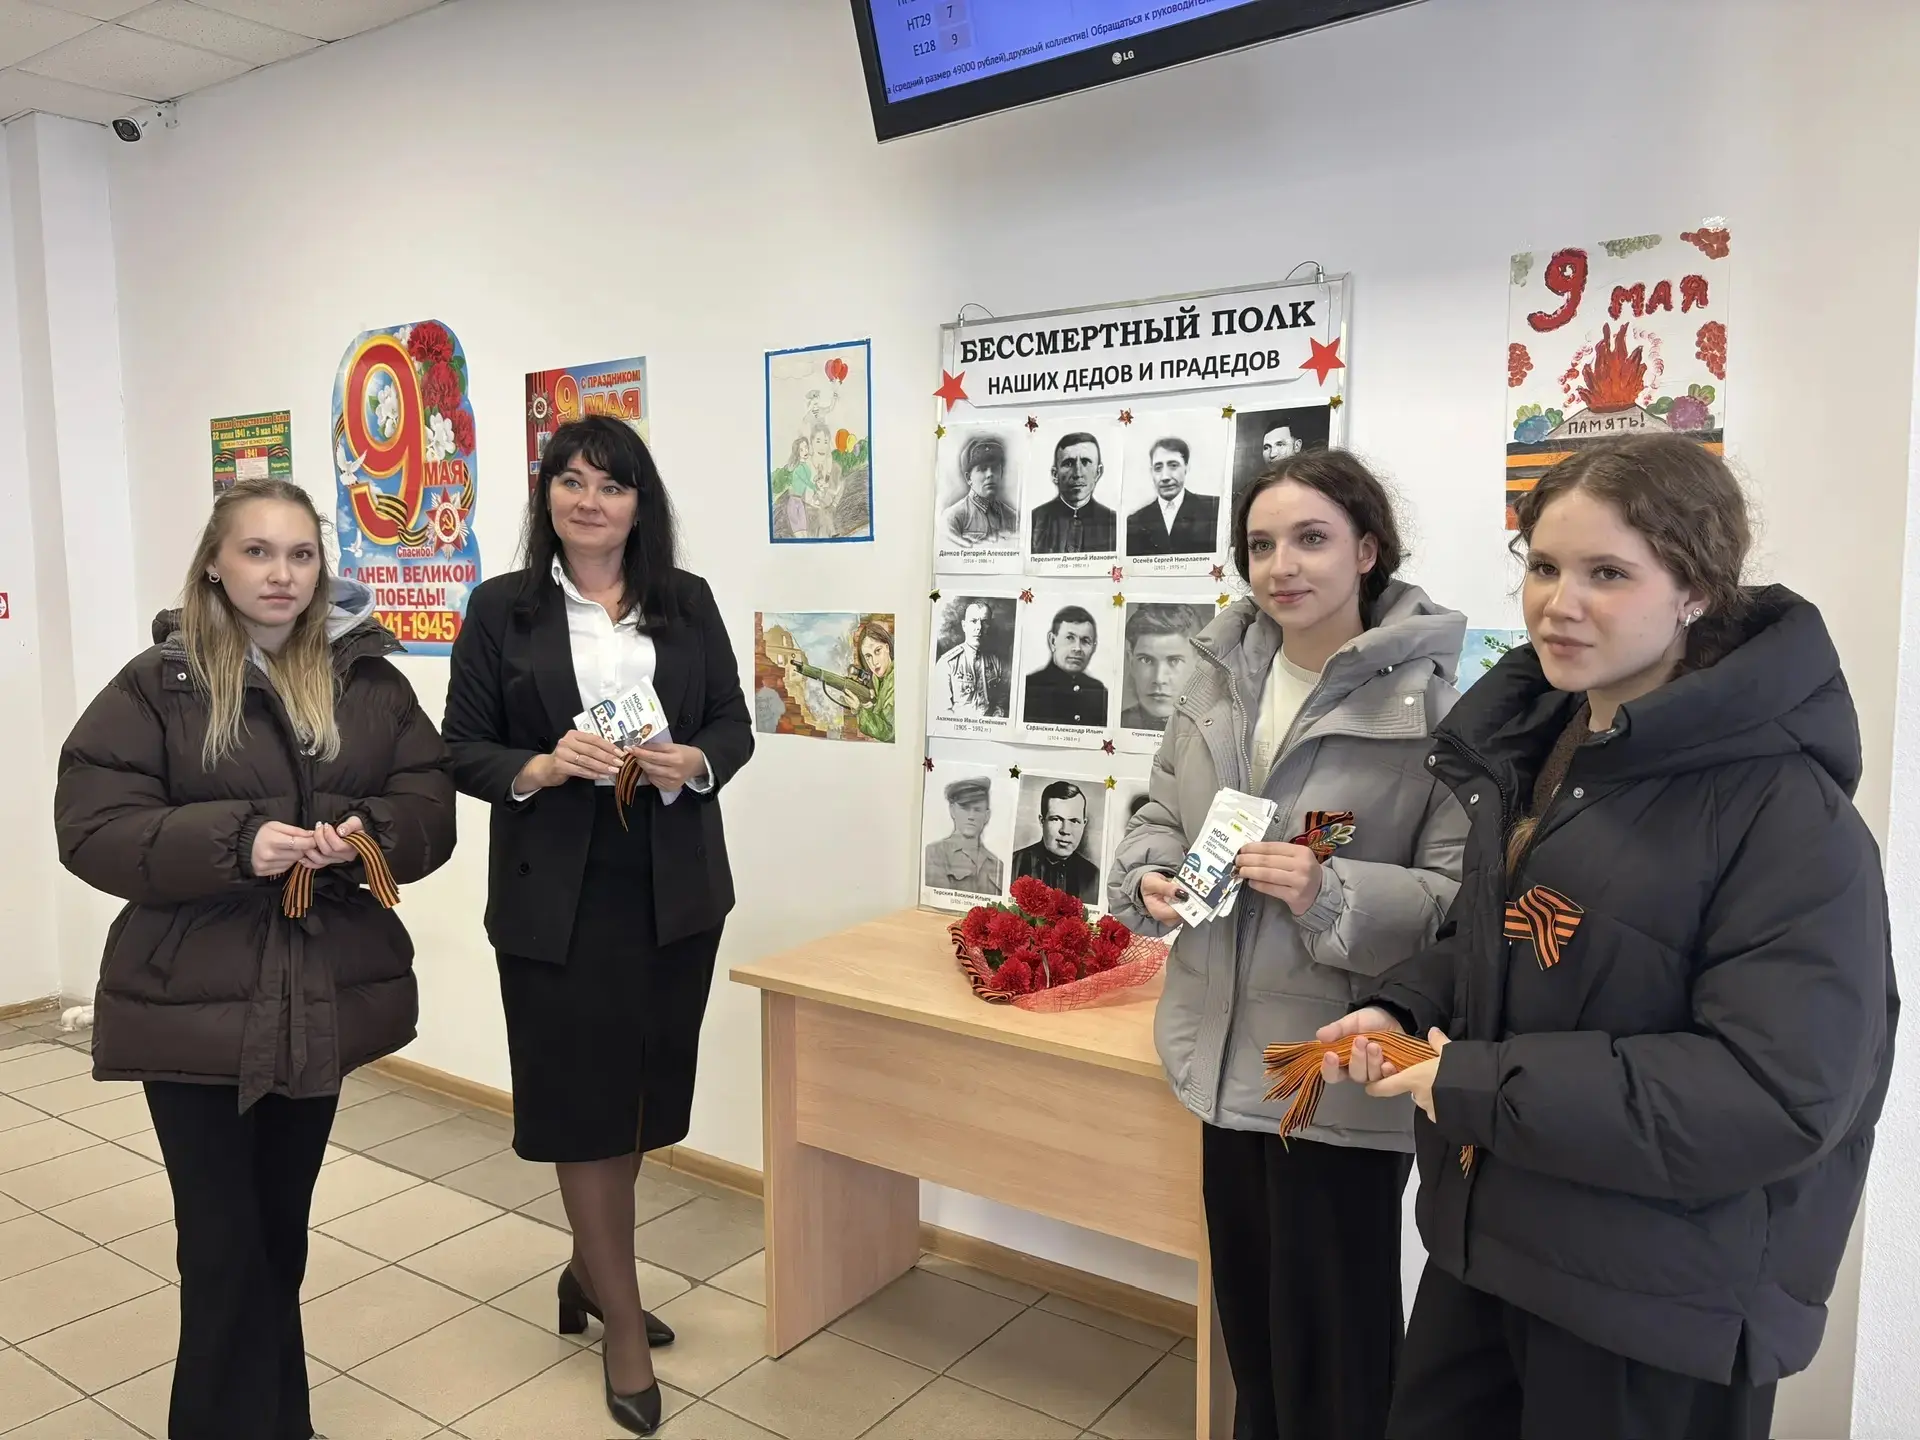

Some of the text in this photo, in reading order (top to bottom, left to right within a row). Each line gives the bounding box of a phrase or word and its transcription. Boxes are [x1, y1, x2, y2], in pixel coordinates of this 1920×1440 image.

[946, 5, 953, 18] 7
[951, 33, 958, 45] 9
[892, 76, 924, 93] (средний
[925, 70, 951, 85] размер
[953, 61, 976, 75] 49000
[1045, 28, 1089, 49] коллектив!
[1091, 14, 1143, 36] Обращаться
[1144, 12, 1150, 21] к
[1123, 50, 1135, 61] LG
[1527, 247, 1709, 333] 9 МАЯ
[960, 301, 1316, 363] БЕССМЕРТНЫЙ ПОЛК
[581, 370, 641, 389] С ПРАЗДНИКОМ!
[988, 350, 1280, 395] НАШИХ ДЕДОВ И ПРАДЕДОВ
[555, 375, 641, 425] 9 МАЯ
[1568, 412, 1645, 435] ПАМЯТЬ!
[344, 334, 465, 546] 9 МАЯ
[245, 448, 258, 459] 1941
[397, 545, 434, 558] Спасибо!
[1062, 554, 1088, 562] Дмитрий
[357, 565, 398, 583] ДНЕМ
[403, 560, 476, 582] ВЕЛИКОЙ
[375, 588, 446, 609] ПОБЕДЫ!
[632, 693, 644, 712] НОСИ
[1055, 726, 1084, 734] Александр
[1211, 827, 1230, 843] НОСИ
[954, 891, 974, 899] Василий
